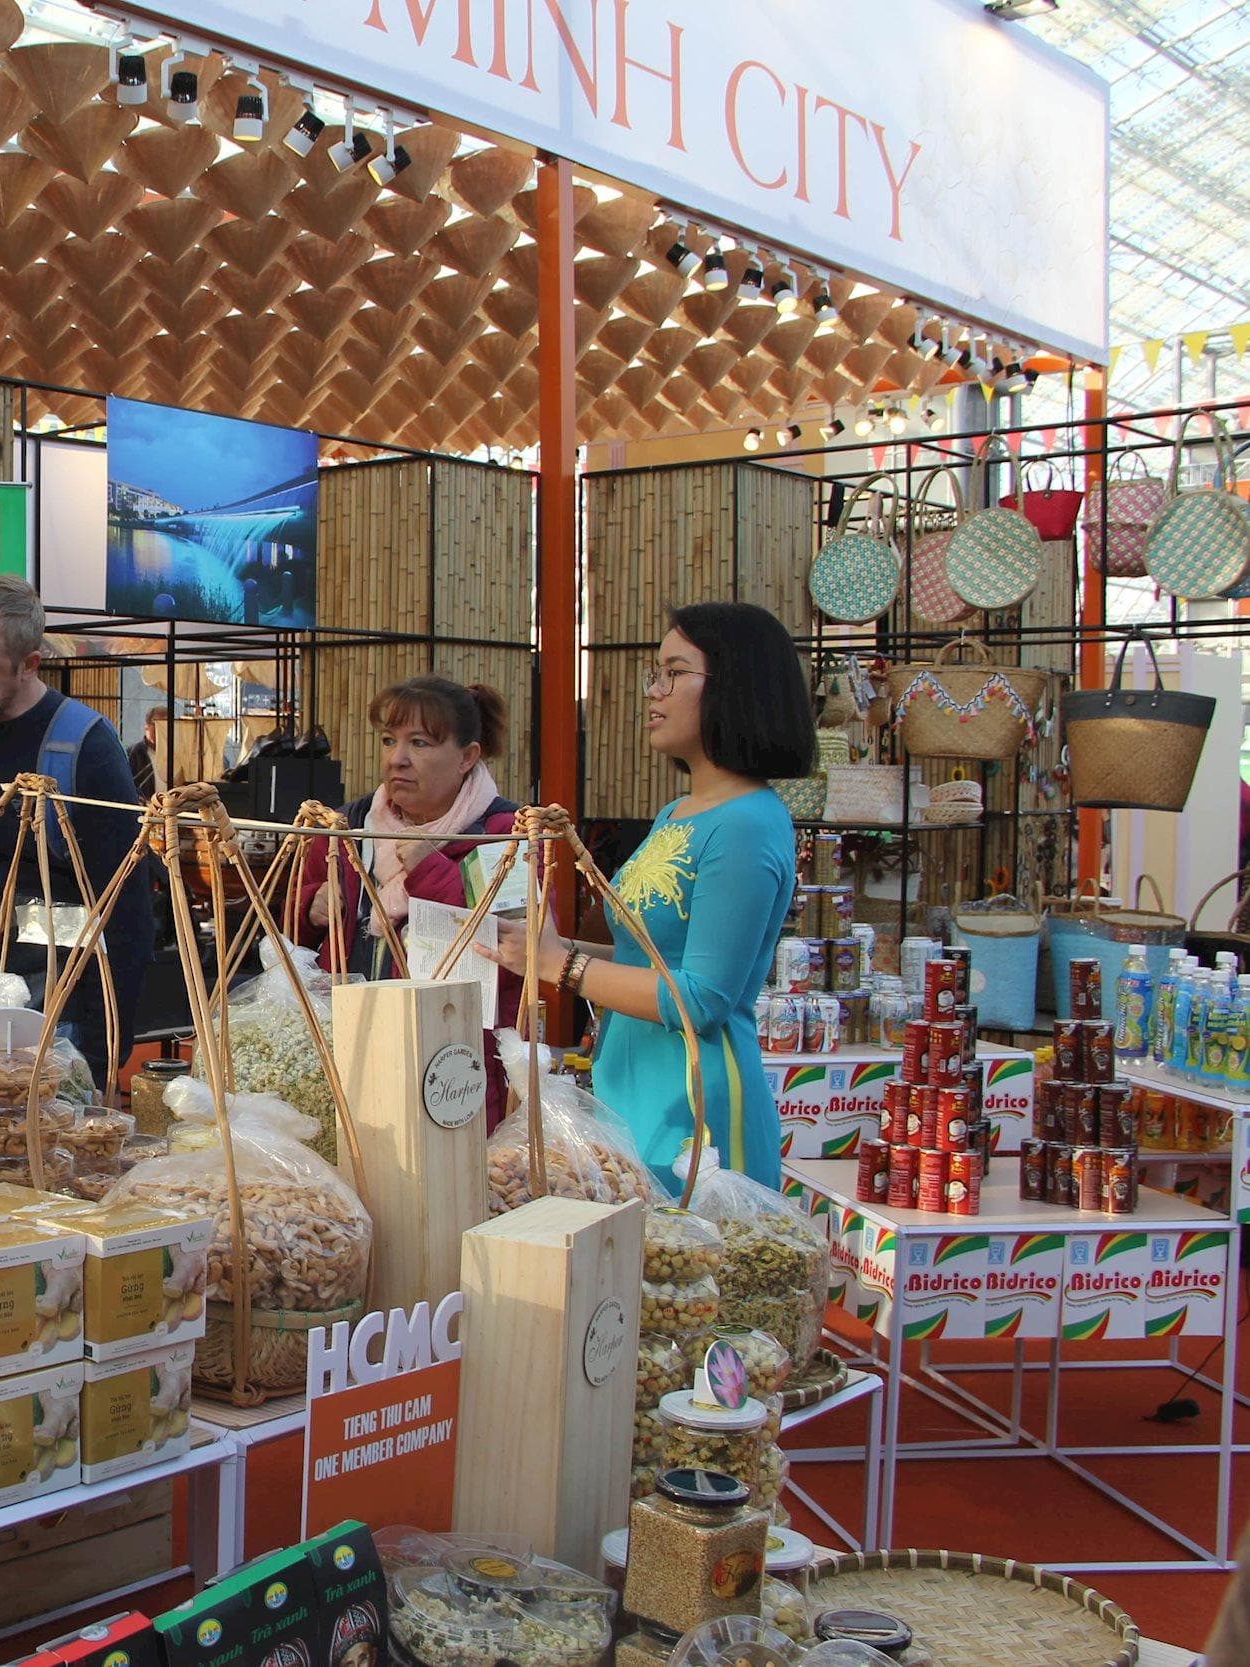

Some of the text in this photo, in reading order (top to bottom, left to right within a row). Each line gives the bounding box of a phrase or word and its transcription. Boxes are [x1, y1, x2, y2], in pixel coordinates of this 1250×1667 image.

[724, 59, 922, 242] CITY
[430, 1077, 482, 1106] Harper
[775, 1099, 821, 1115] idrico
[984, 1093, 1028, 1109] drico
[831, 1240, 859, 1269] Bidrico
[909, 1269, 1221, 1291] Bidrico Bidrico Bidrico Bidrico
[307, 1291, 463, 1399] HCMC
[343, 1394, 432, 1440] TIENG THU CAM
[315, 1418, 453, 1481] ONE MEMBER COMPANY
[324, 1570, 377, 1603] Trà xanh
[251, 1606, 309, 1645] Trà xanh
